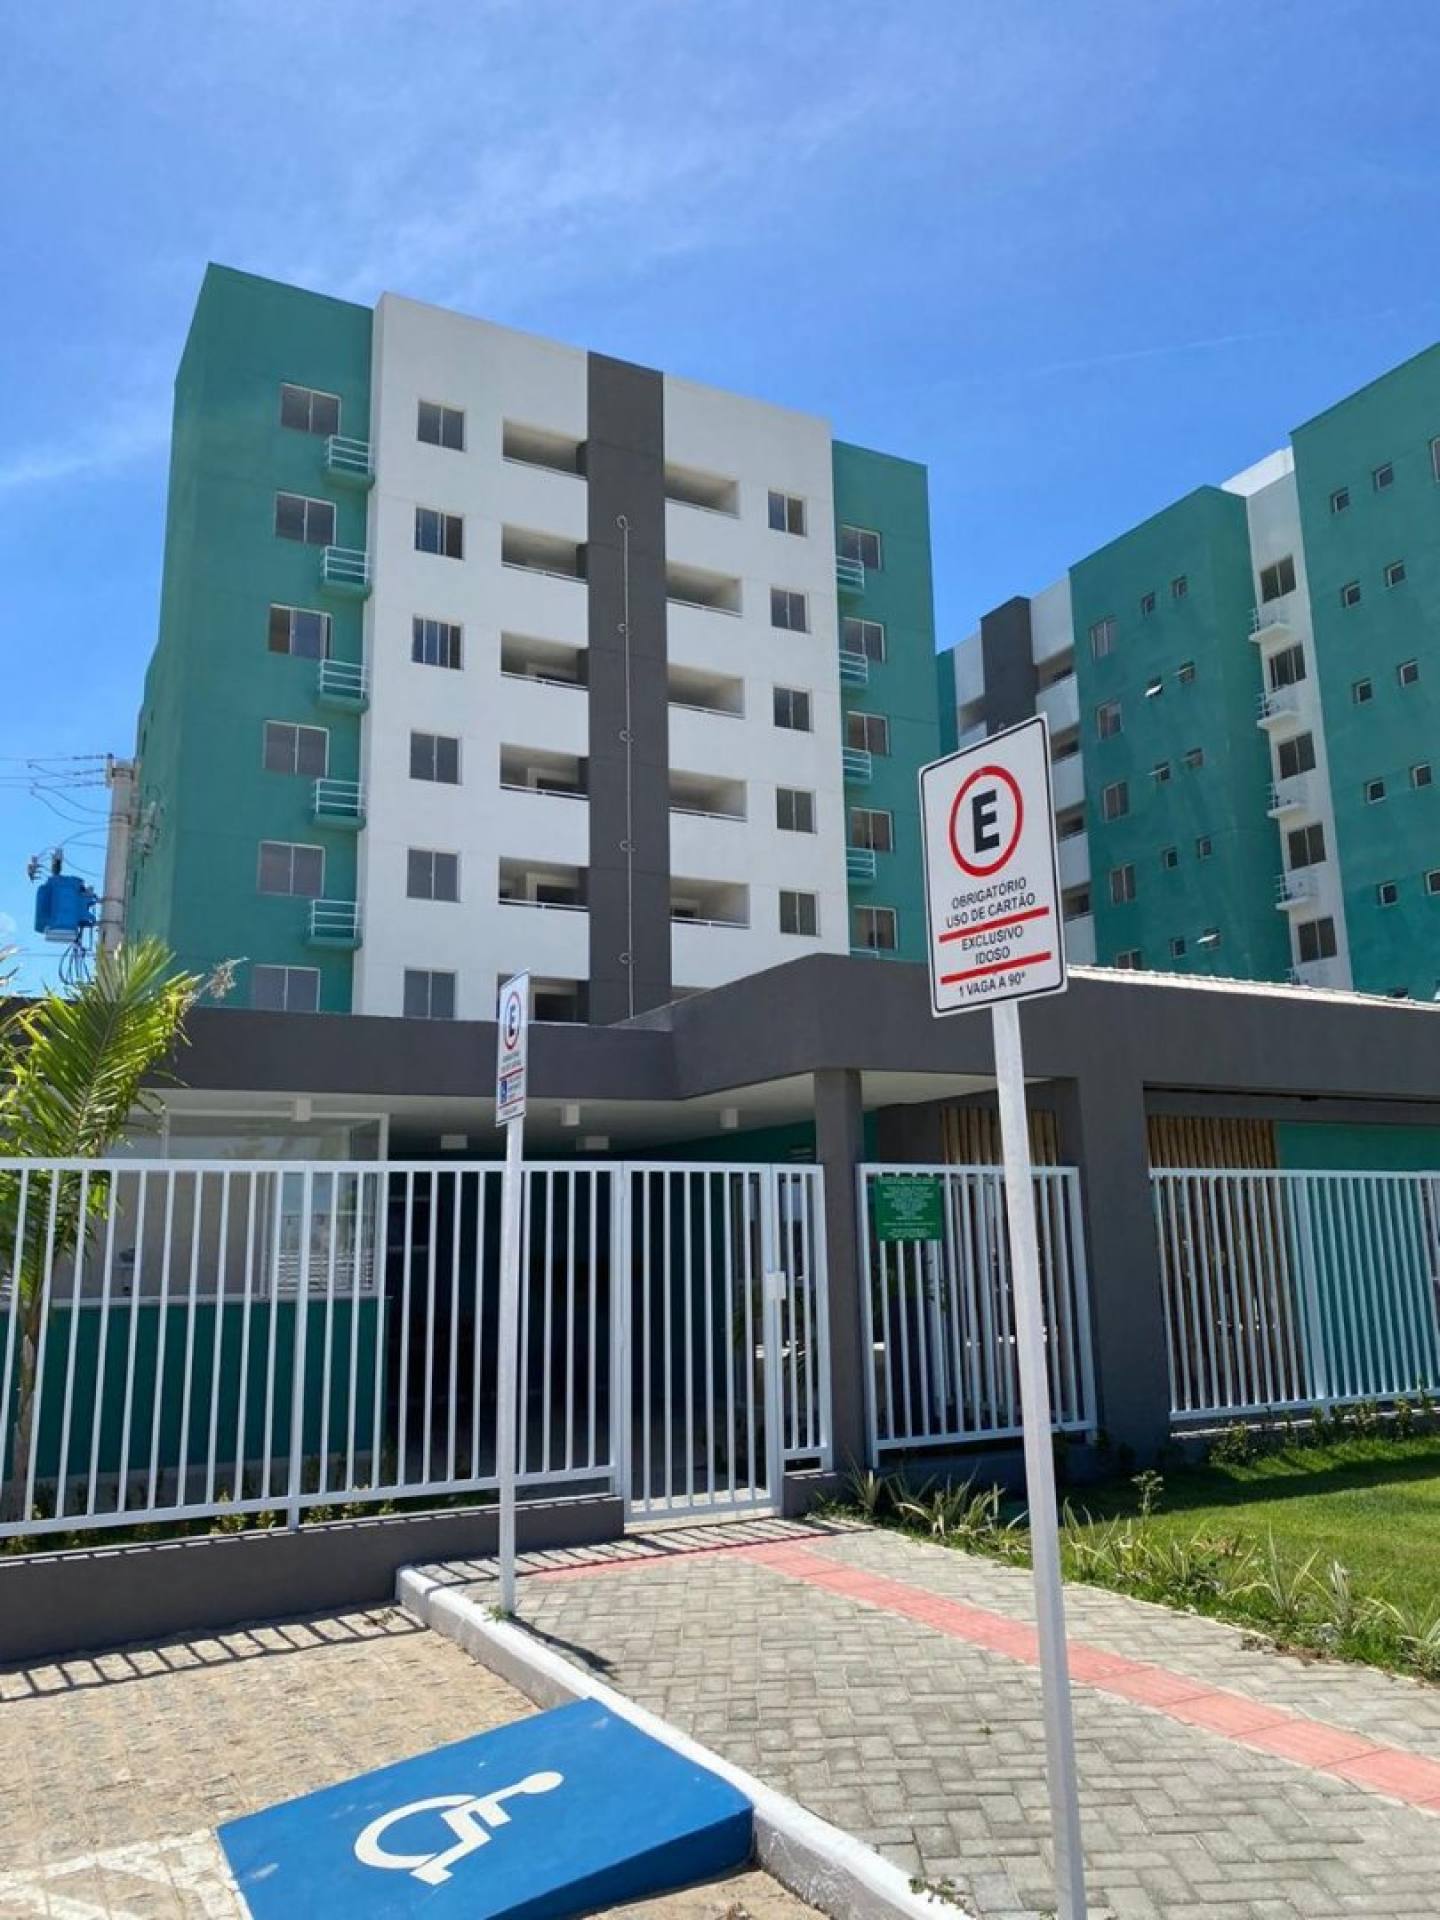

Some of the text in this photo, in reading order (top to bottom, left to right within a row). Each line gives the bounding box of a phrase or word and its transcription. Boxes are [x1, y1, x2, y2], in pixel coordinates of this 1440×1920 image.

[971, 788, 1000, 854] E
[946, 892, 1035, 928] USO DE CARTÃO
[961, 925, 1023, 951] EXCLUSIVO
[975, 945, 1010, 966] IDOSO
[959, 986, 964, 997] 1
[966, 979, 996, 996] VAGA
[999, 976, 1006, 987] A
